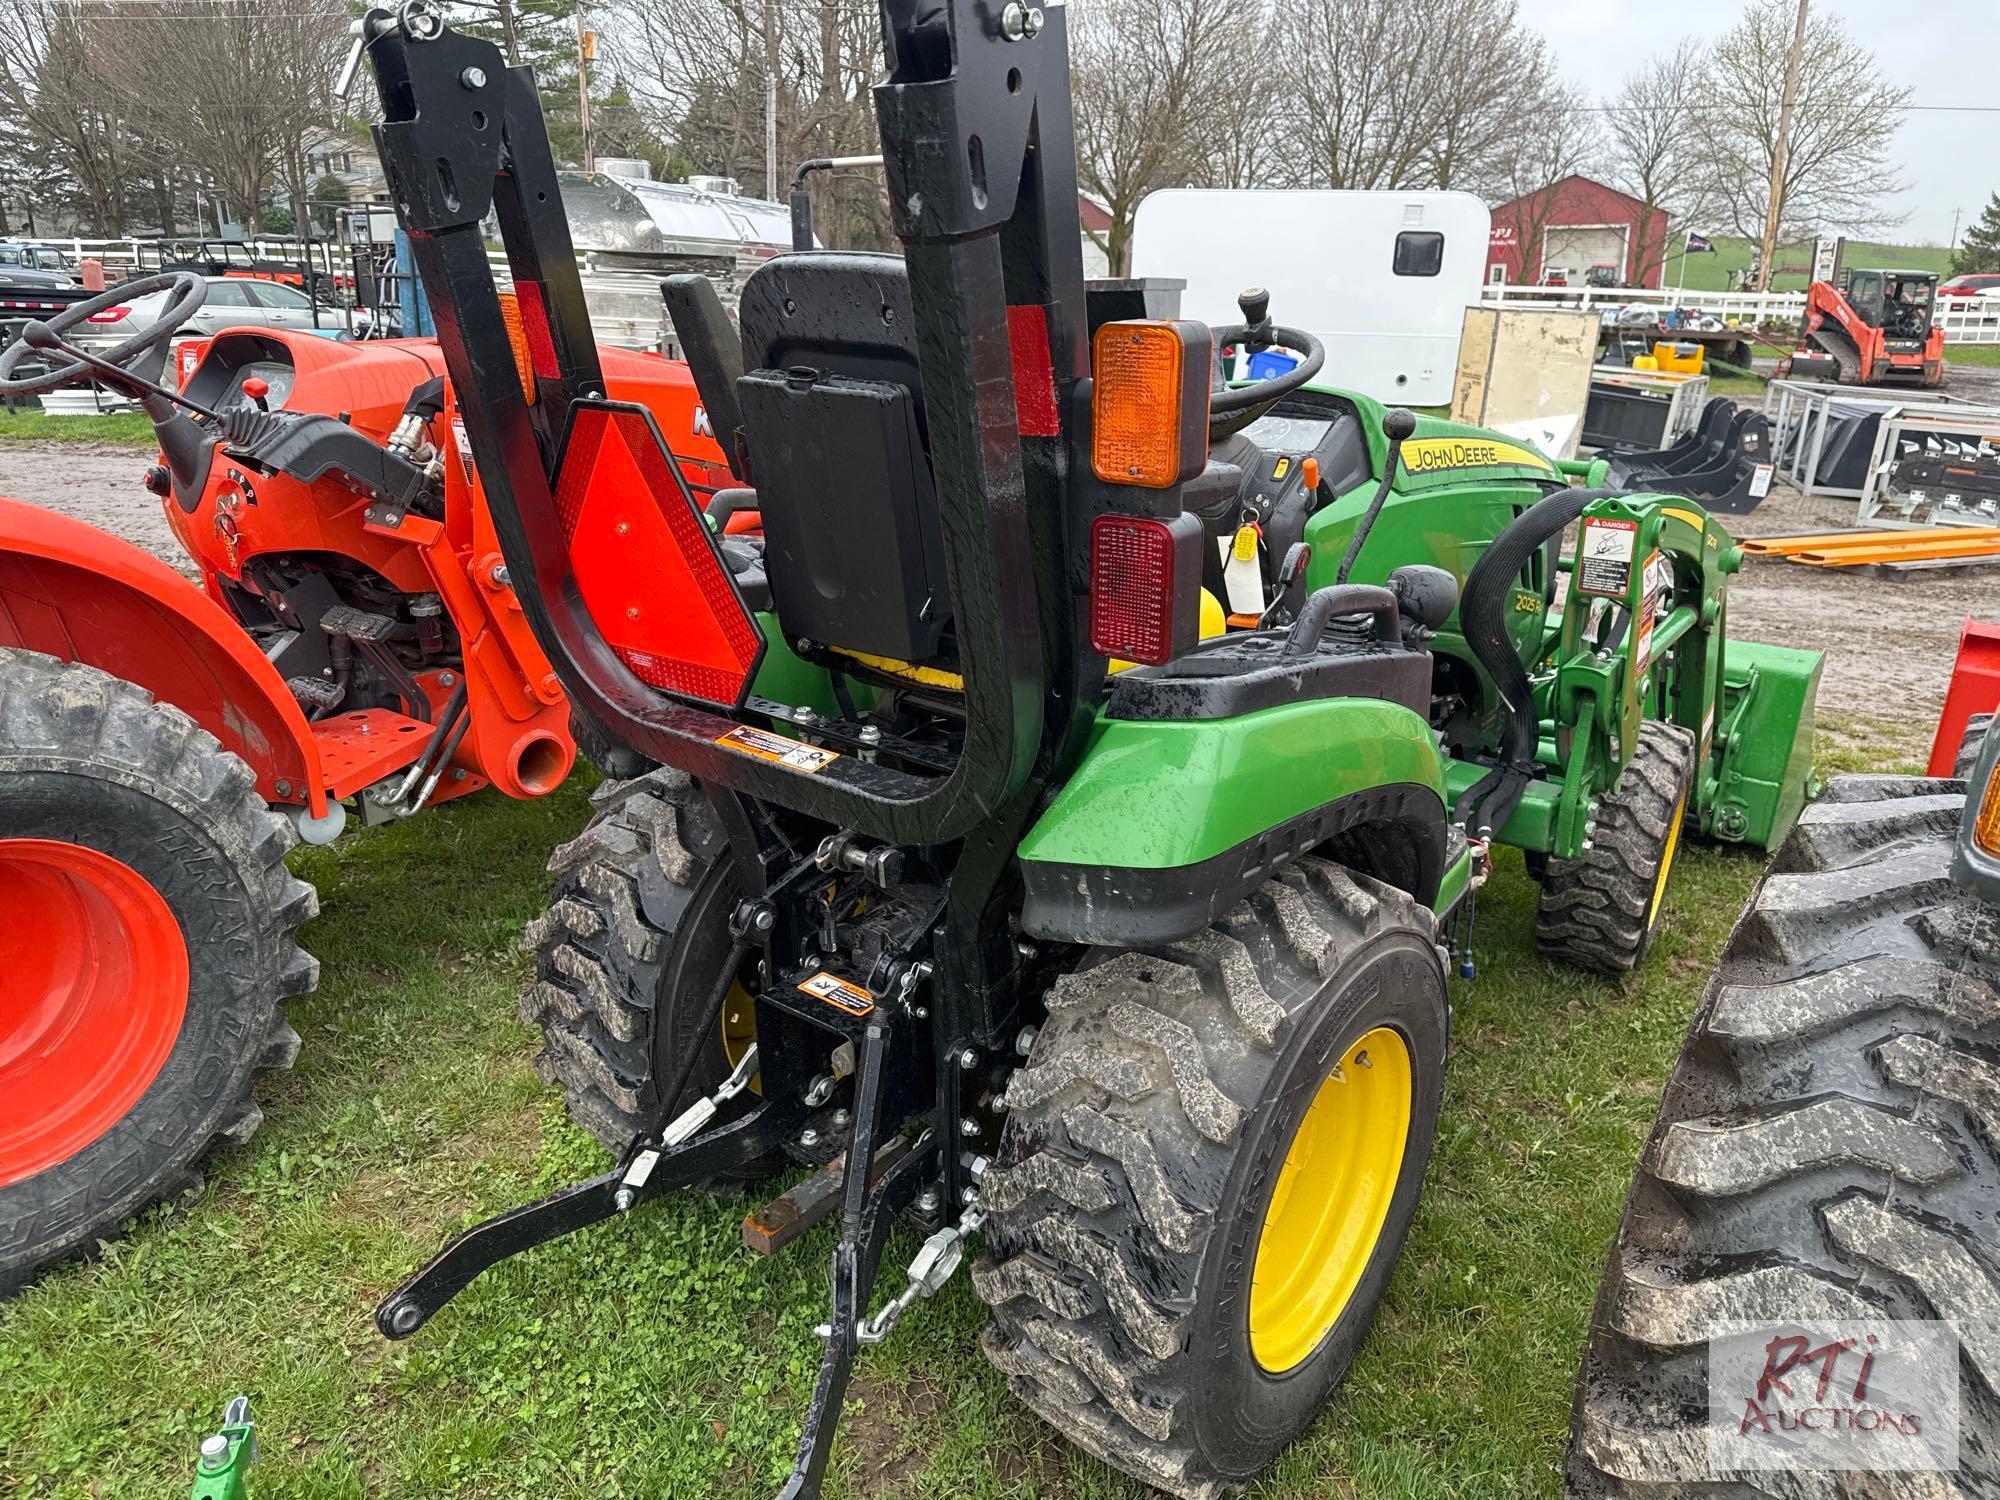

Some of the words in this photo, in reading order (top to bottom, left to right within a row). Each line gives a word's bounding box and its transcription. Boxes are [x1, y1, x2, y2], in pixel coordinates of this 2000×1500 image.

[1416, 447, 1453, 469] JOHN
[1454, 444, 1498, 464] DEERE
[1601, 521, 1631, 530] DANGER
